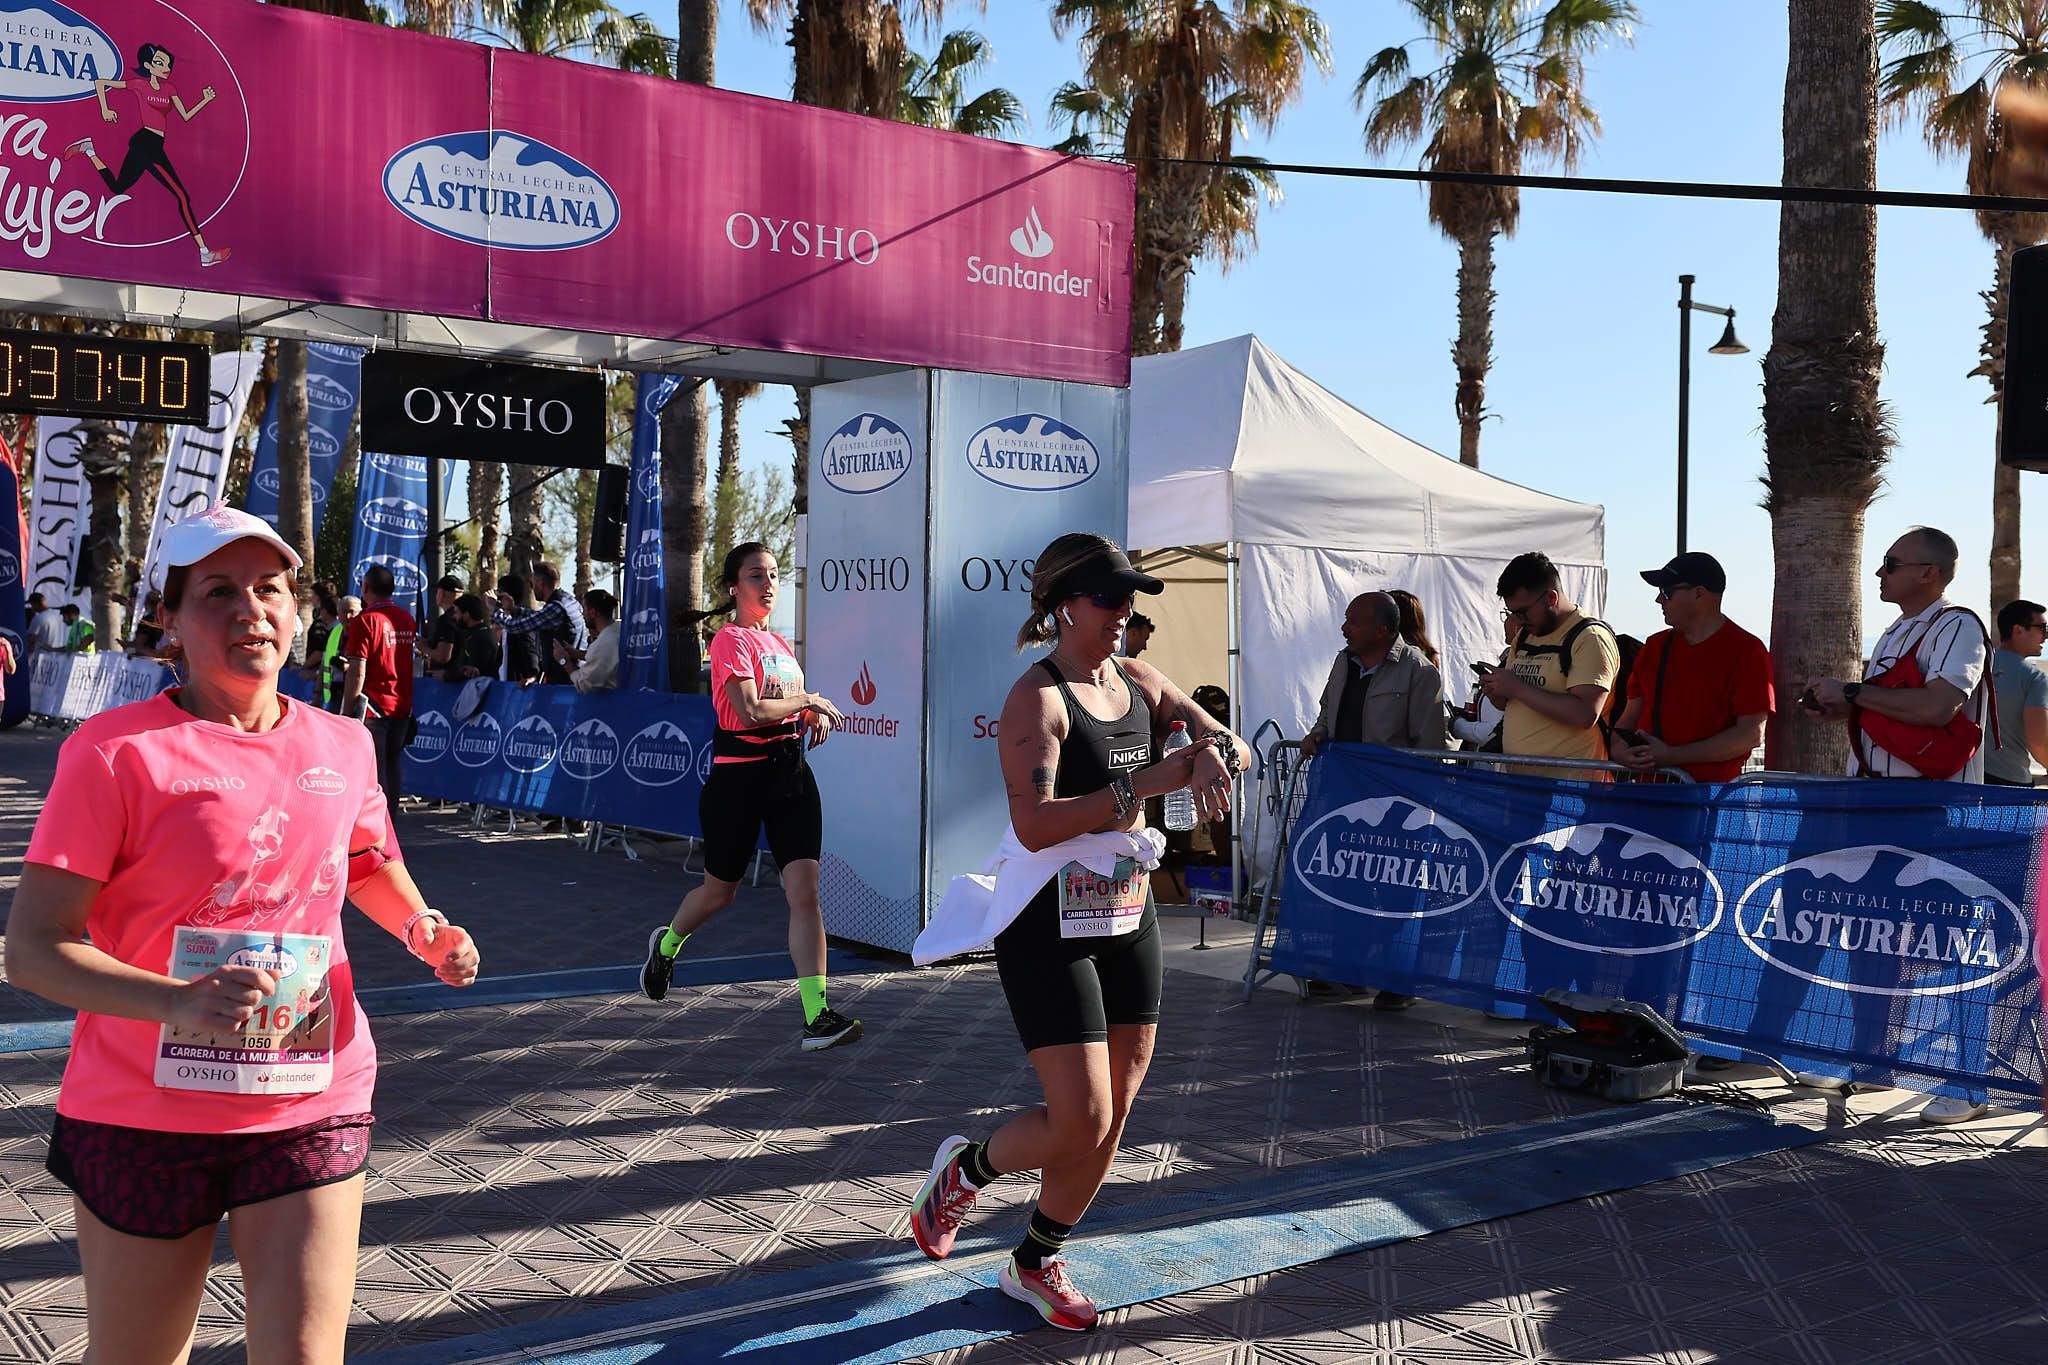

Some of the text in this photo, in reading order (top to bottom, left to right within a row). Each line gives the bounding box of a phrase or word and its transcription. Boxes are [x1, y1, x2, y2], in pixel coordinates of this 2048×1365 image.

[6, 22, 92, 46] LECHERA
[441, 164, 596, 195] CENTRAL LECHERA
[402, 161, 603, 229] ASTURIANA
[725, 212, 880, 265] OYSHO
[967, 255, 1093, 297] Santander
[404, 387, 573, 435] OYSHO
[976, 438, 1089, 474] ASTURIANA
[997, 439, 1086, 452] CENTRAL LECHERA
[827, 446, 905, 476] ASTURIANA
[821, 556, 910, 592] OYSHO
[961, 556, 1036, 592] OYS
[413, 735, 447, 750] STURIANA
[456, 733, 497, 754] ASTURIANA
[506, 735, 552, 760] ASTURIANA
[563, 738, 612, 765] ASTURIANA
[1113, 748, 1147, 764] NIKE
[627, 743, 686, 771] ASTURIANA
[172, 776, 245, 795] OYSHO
[1340, 831, 1469, 858] CENTRAL LECHERA
[1304, 831, 1469, 896] ASTURIANA
[1543, 857, 1700, 889] CENTRAL LECHERA
[1503, 857, 1701, 930] ASTURIANA
[1802, 888, 1997, 920] CENTRAL LECHERA
[1066, 910, 1094, 919] CARRERA
[1095, 909, 1104, 918] DE
[1104, 908, 1112, 917] LA
[1073, 922, 1108, 931] OYSHO
[1751, 887, 2000, 968] ASTURIANA
[242, 1004, 291, 1030] 16
[170, 1046, 323, 1062] CARRERA DE LA MUJER VALENCIA
[241, 1037, 272, 1049] 1050
[177, 1065, 236, 1082] OYSHO
[271, 1072, 315, 1083] Santander
